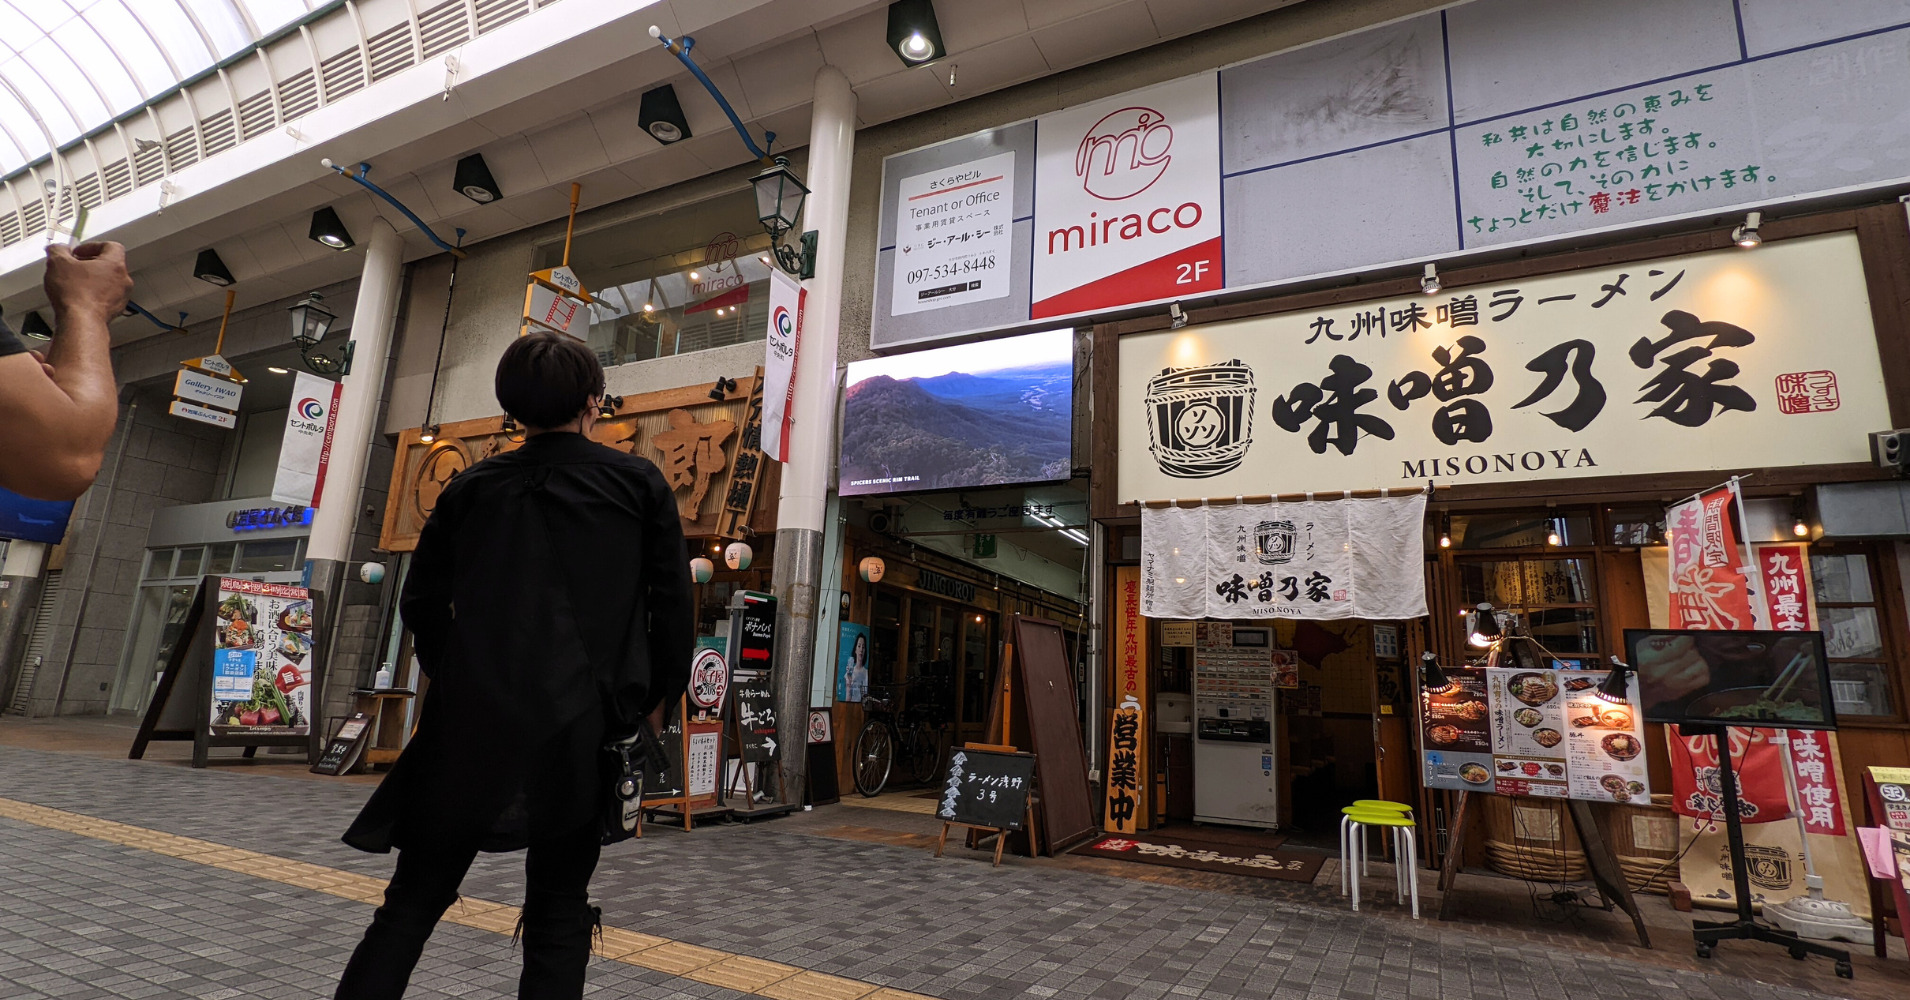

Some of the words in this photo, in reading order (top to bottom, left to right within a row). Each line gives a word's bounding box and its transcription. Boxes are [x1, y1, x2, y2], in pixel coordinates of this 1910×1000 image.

[1482, 83, 1714, 147] 私共は自然の恵みを
[1525, 117, 1670, 159] 大切にします。
[1490, 131, 1717, 189] 自然の力を信じます。
[930, 169, 982, 190] さくらやビル
[1517, 159, 1690, 204] そして、その力に
[910, 202, 948, 219] Tenant
[951, 200, 963, 210] or
[965, 191, 1000, 207] Office
[915, 209, 991, 232] 事業用賃貸スペース
[1048, 201, 1203, 256] miraco
[553, 270, 579, 288] セントポルタ
[907, 254, 996, 285] 097-534-8448
[1176, 258, 1211, 286] 2F
[692, 273, 744, 296] miraco
[1304, 269, 1686, 345] 九州味噌ラーメン
[769, 334, 793, 358] セントポルタ
[184, 378, 213, 392] Gallery
[1271, 309, 1757, 457] 味噌乃家
[290, 419, 325, 434] セントポルタ
[1401, 446, 1599, 480] MISONOYA
[872, 477, 892, 485] SCENIC
[1305, 521, 1315, 562] ラーメン
[1215, 570, 1332, 604] 味噌乃家
[1252, 605, 1302, 616] MISONOYA
[967, 772, 1024, 791] ラーメン浅野
[1109, 713, 1139, 831] 営業中
[976, 788, 998, 804] 3号
